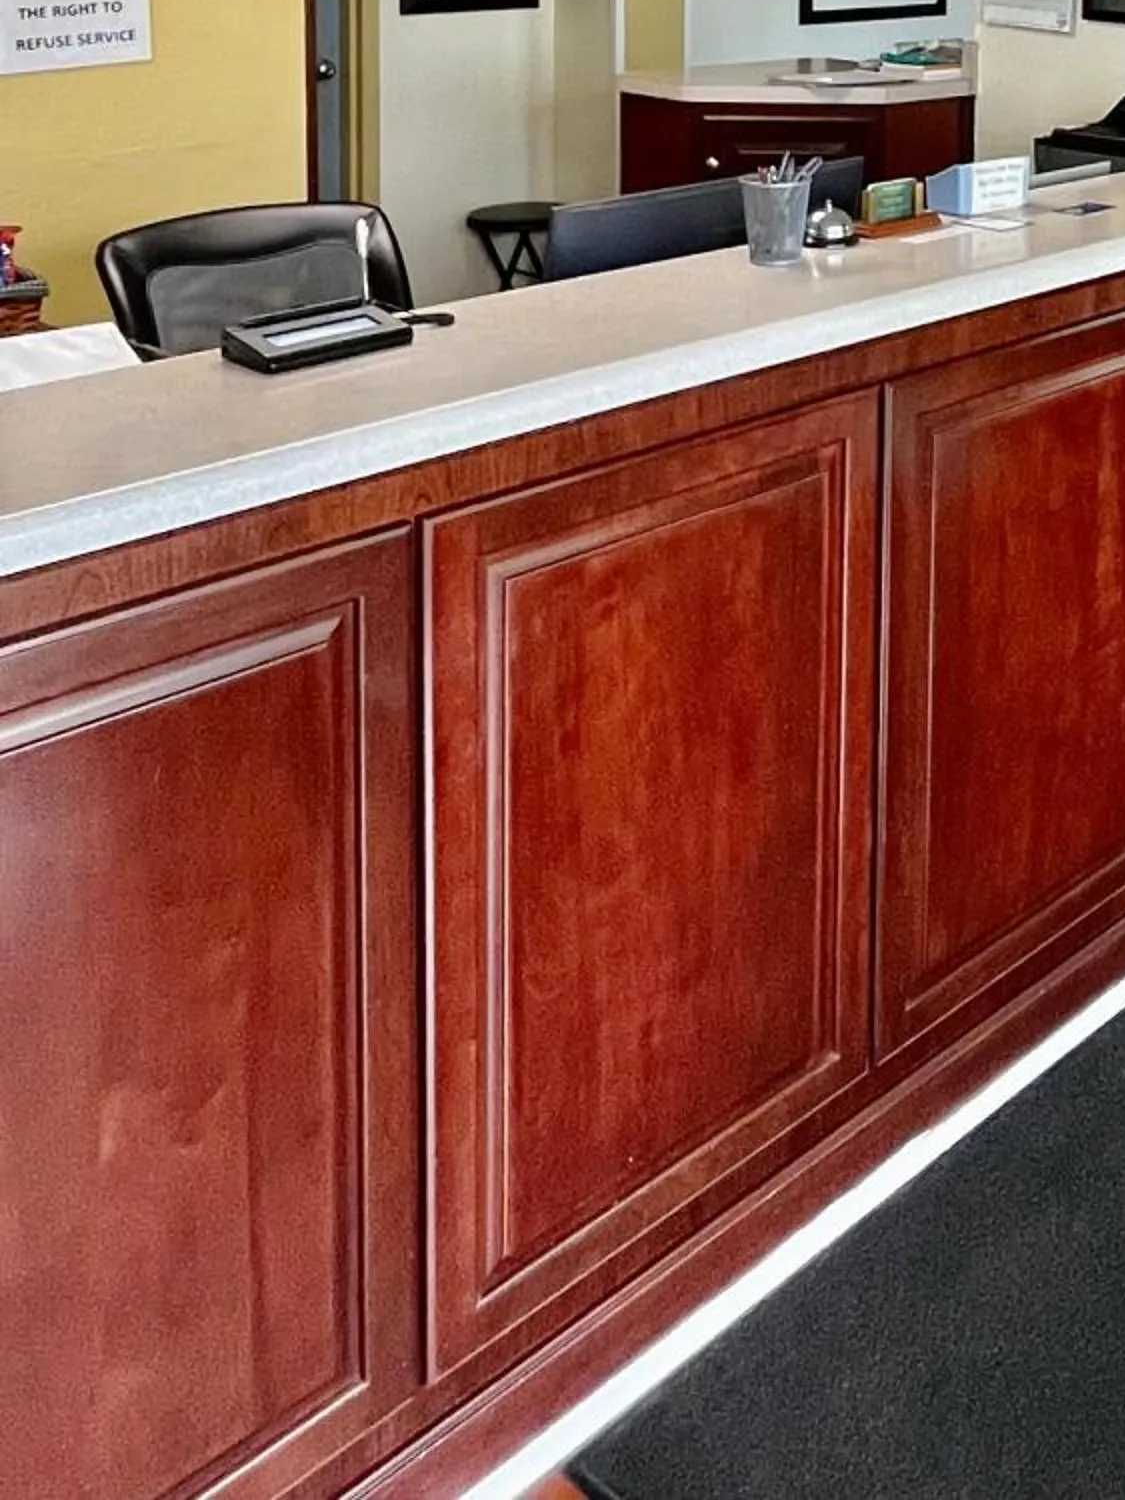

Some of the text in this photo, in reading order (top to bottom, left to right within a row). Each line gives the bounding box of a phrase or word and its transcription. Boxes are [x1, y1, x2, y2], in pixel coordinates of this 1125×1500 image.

[18, 1, 123, 20] THE RIGHT TO
[15, 29, 136, 51] REFUSE SERVICE
